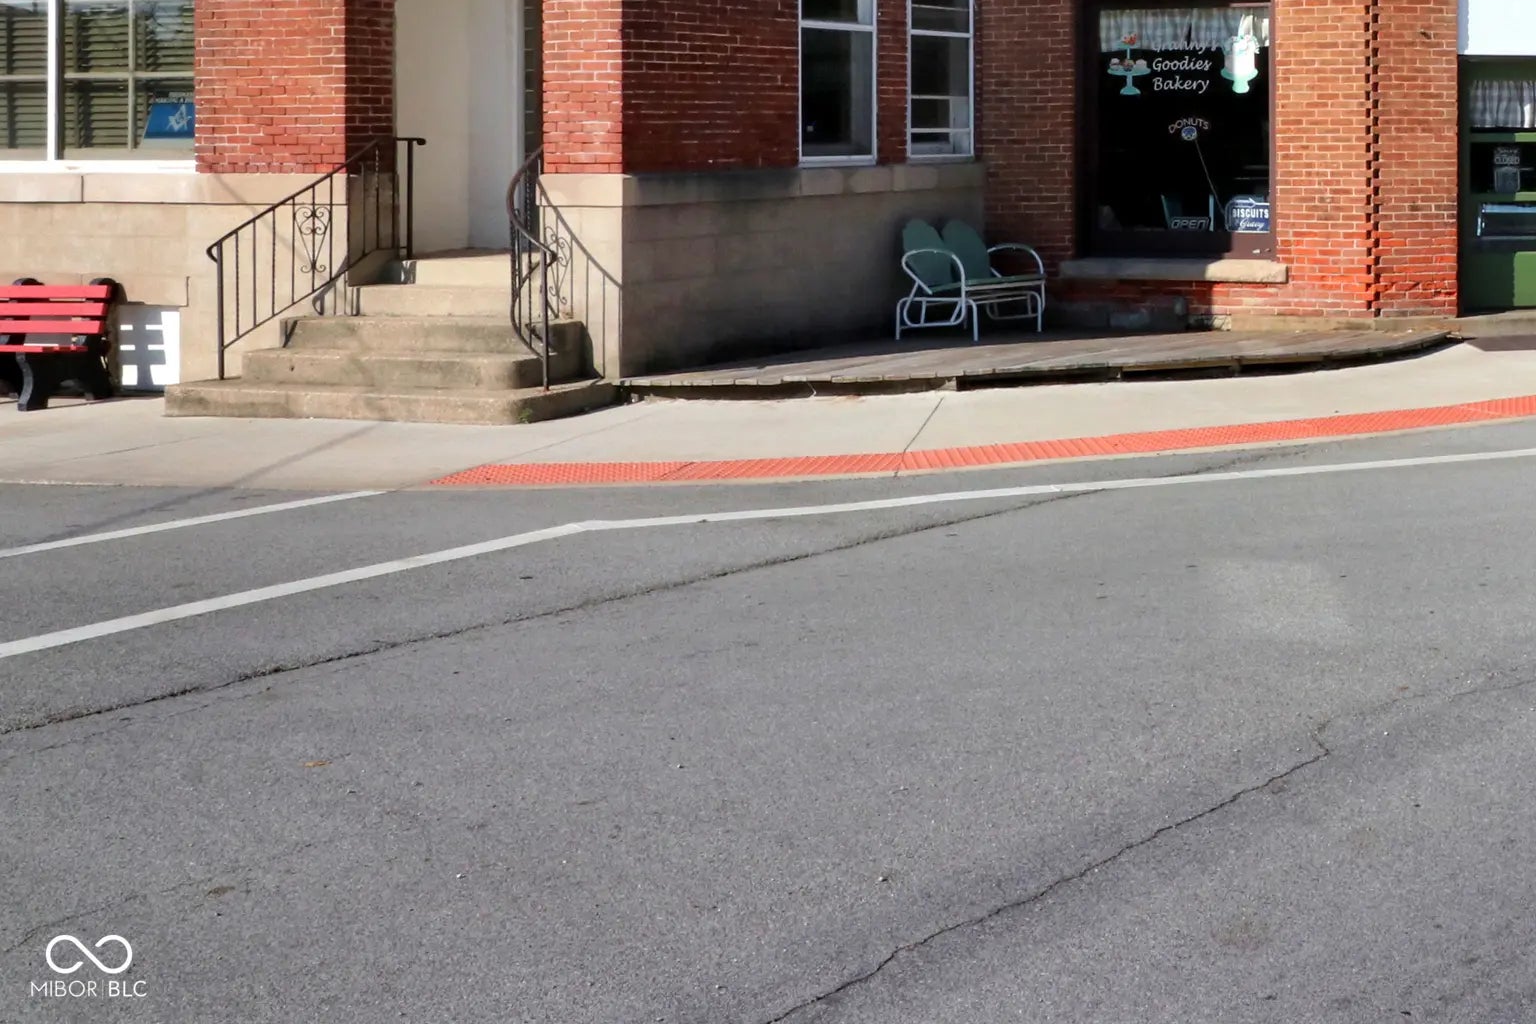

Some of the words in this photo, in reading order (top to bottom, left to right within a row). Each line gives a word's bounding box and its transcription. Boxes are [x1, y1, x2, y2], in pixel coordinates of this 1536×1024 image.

[1152, 38, 1219, 55] Granny's
[1152, 57, 1212, 72] Goodies
[1153, 77, 1210, 93] Bakery
[1168, 117, 1209, 134] DONUTS
[1232, 208, 1269, 219] BISCUITS
[1171, 219, 1206, 229] OPEN
